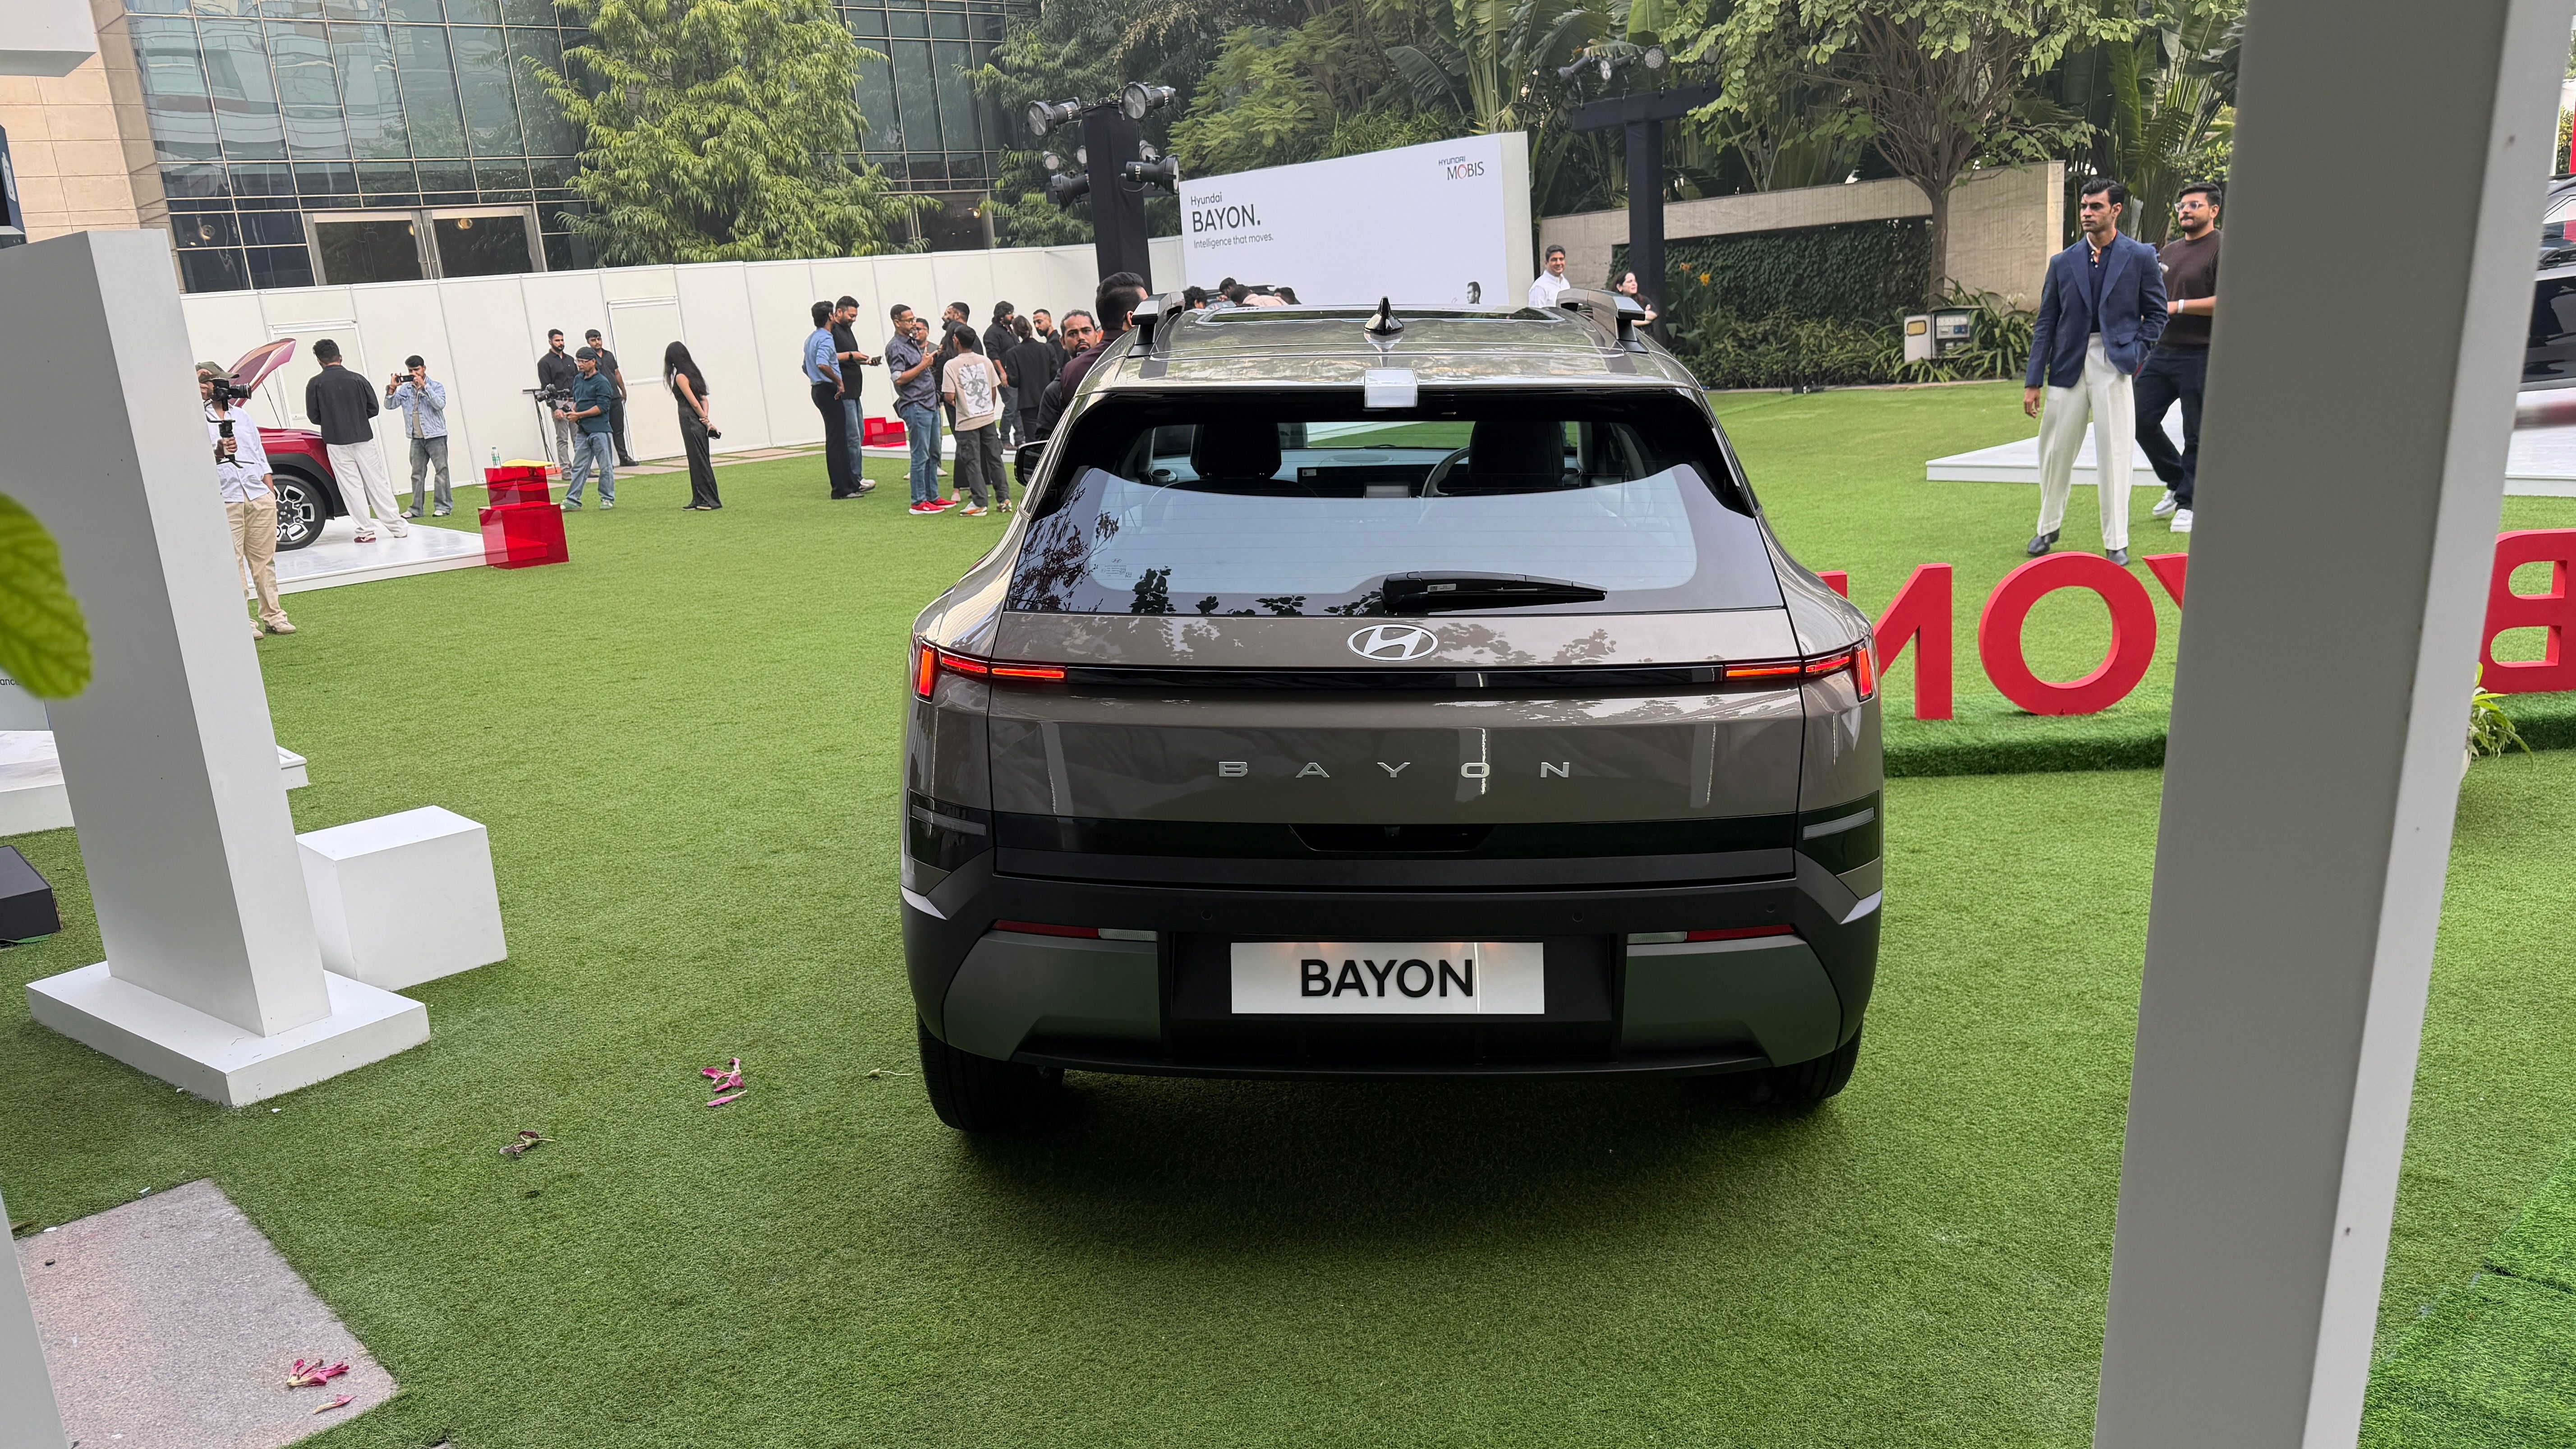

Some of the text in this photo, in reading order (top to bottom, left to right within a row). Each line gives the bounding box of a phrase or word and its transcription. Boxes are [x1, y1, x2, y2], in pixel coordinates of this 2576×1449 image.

[1438, 156, 1466, 166] HYUNDAI
[1447, 161, 1485, 180] MOBIS
[1191, 192, 1223, 207] Hyundai
[1192, 204, 1261, 233] BAYON.
[1194, 233, 1274, 249] Intelligence that moves.
[1218, 761, 1570, 778] BAYON
[1301, 959, 1473, 998] BAYON
